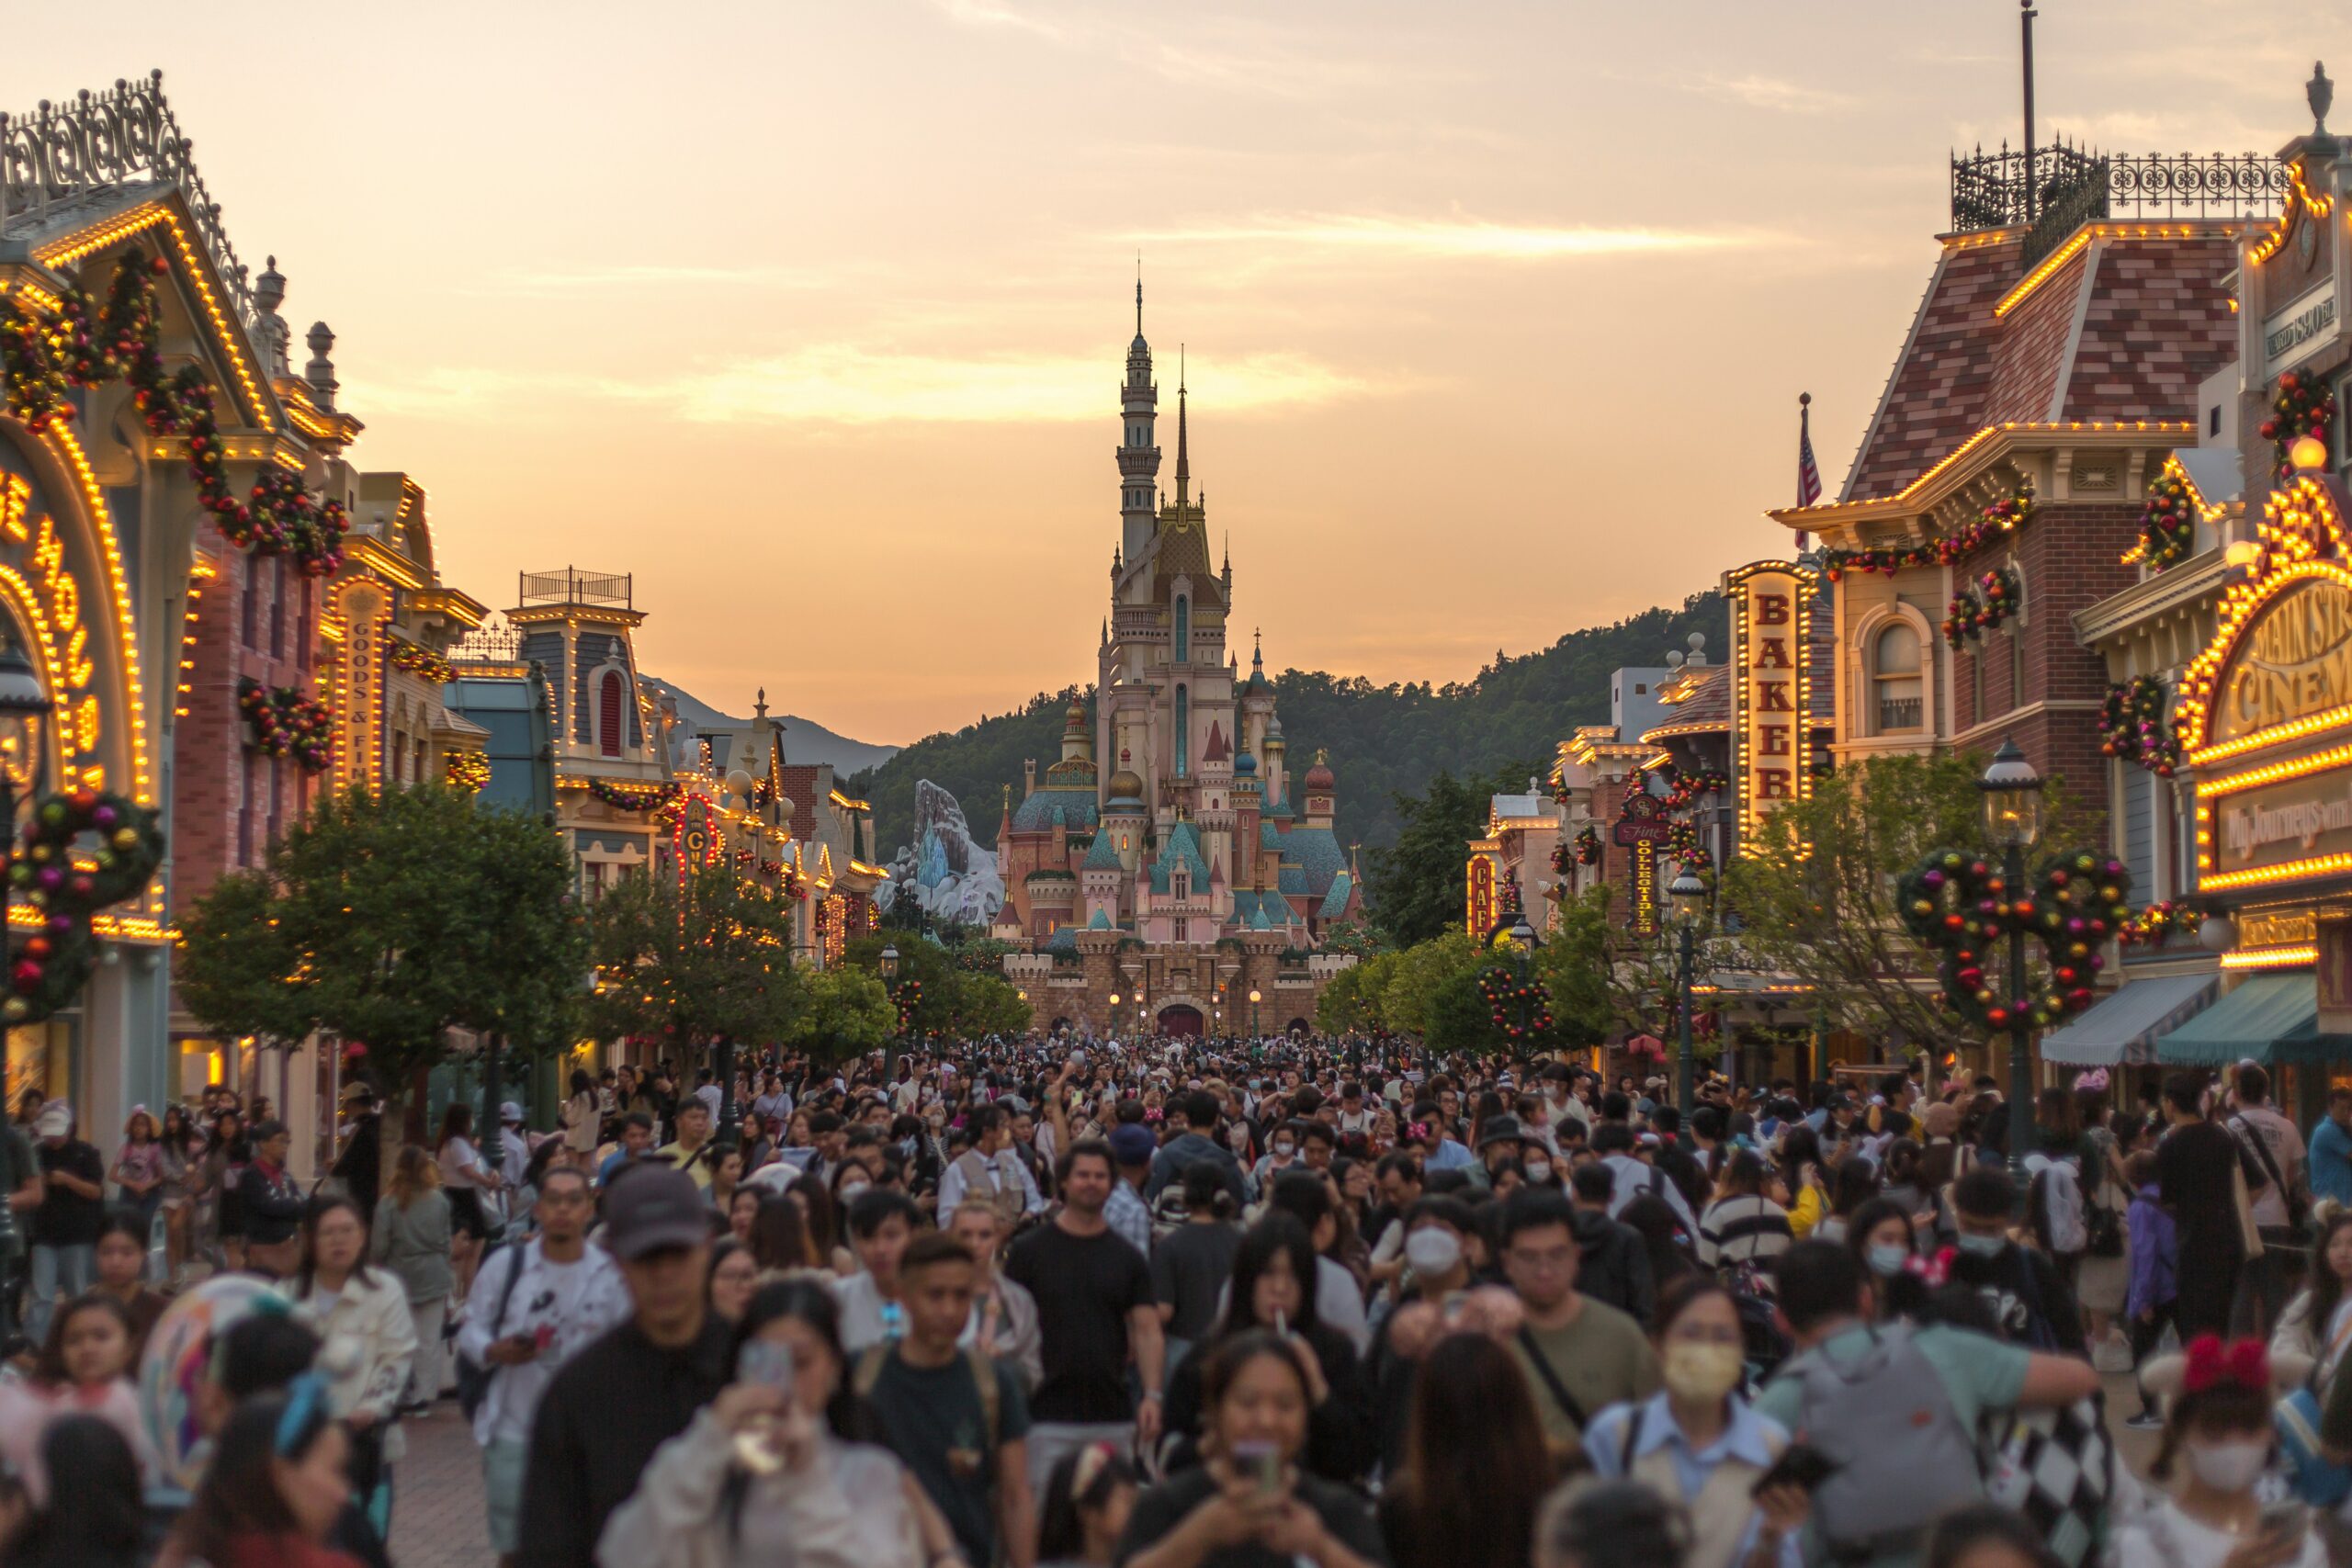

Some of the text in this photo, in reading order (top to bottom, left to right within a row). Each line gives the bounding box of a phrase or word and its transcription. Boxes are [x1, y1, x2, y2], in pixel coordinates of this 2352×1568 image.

[2294, 304, 2321, 343] 1890
[2255, 589, 2309, 665] MAIN
[353, 623, 368, 700] GOODS
[351, 711, 368, 724] &
[1623, 826, 1665, 840] Fine
[2229, 807, 2255, 861] My
[2252, 799, 2324, 849] Journeys
[1637, 839, 1653, 933] COLLECTIBLES
